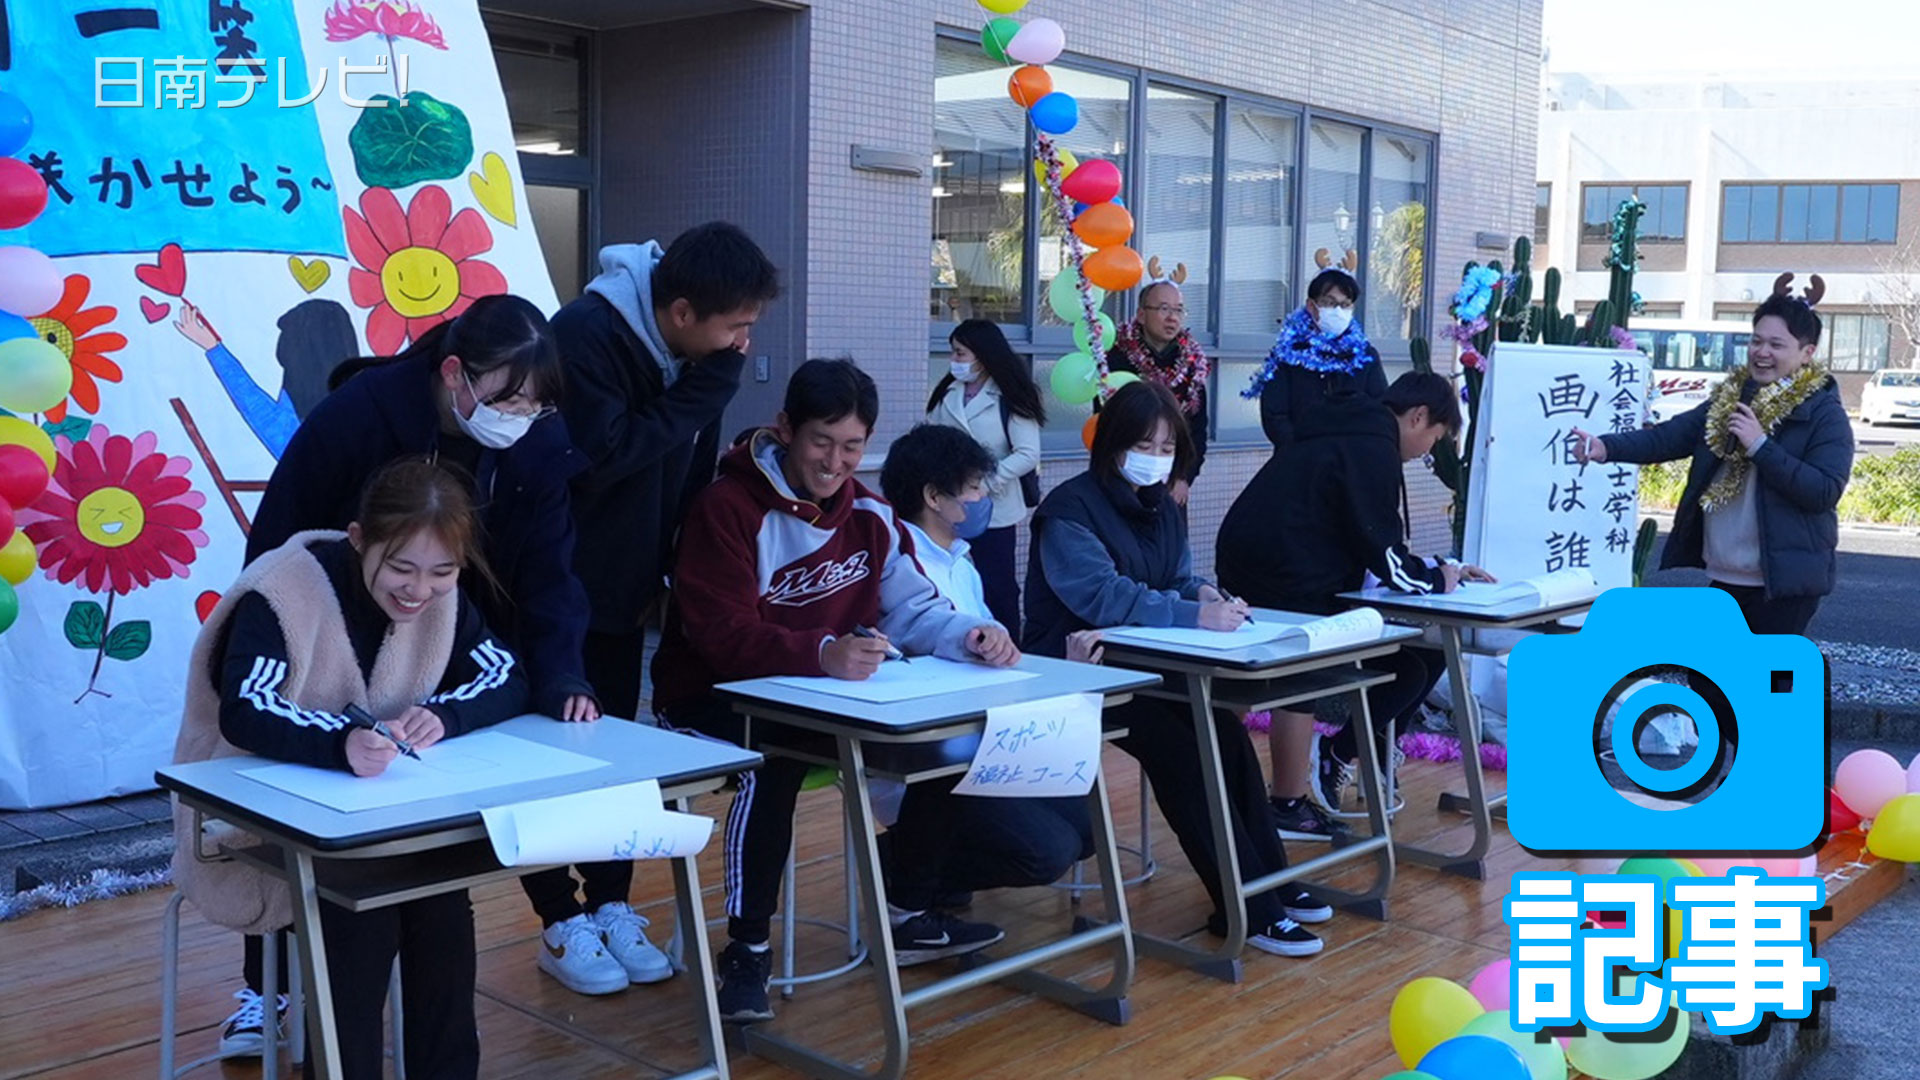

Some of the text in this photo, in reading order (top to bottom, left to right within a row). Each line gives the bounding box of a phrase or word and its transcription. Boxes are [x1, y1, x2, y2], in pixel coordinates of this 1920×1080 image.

[1602, 359, 1640, 554] 社会福士学科
[986, 716, 1067, 756] スポーツ
